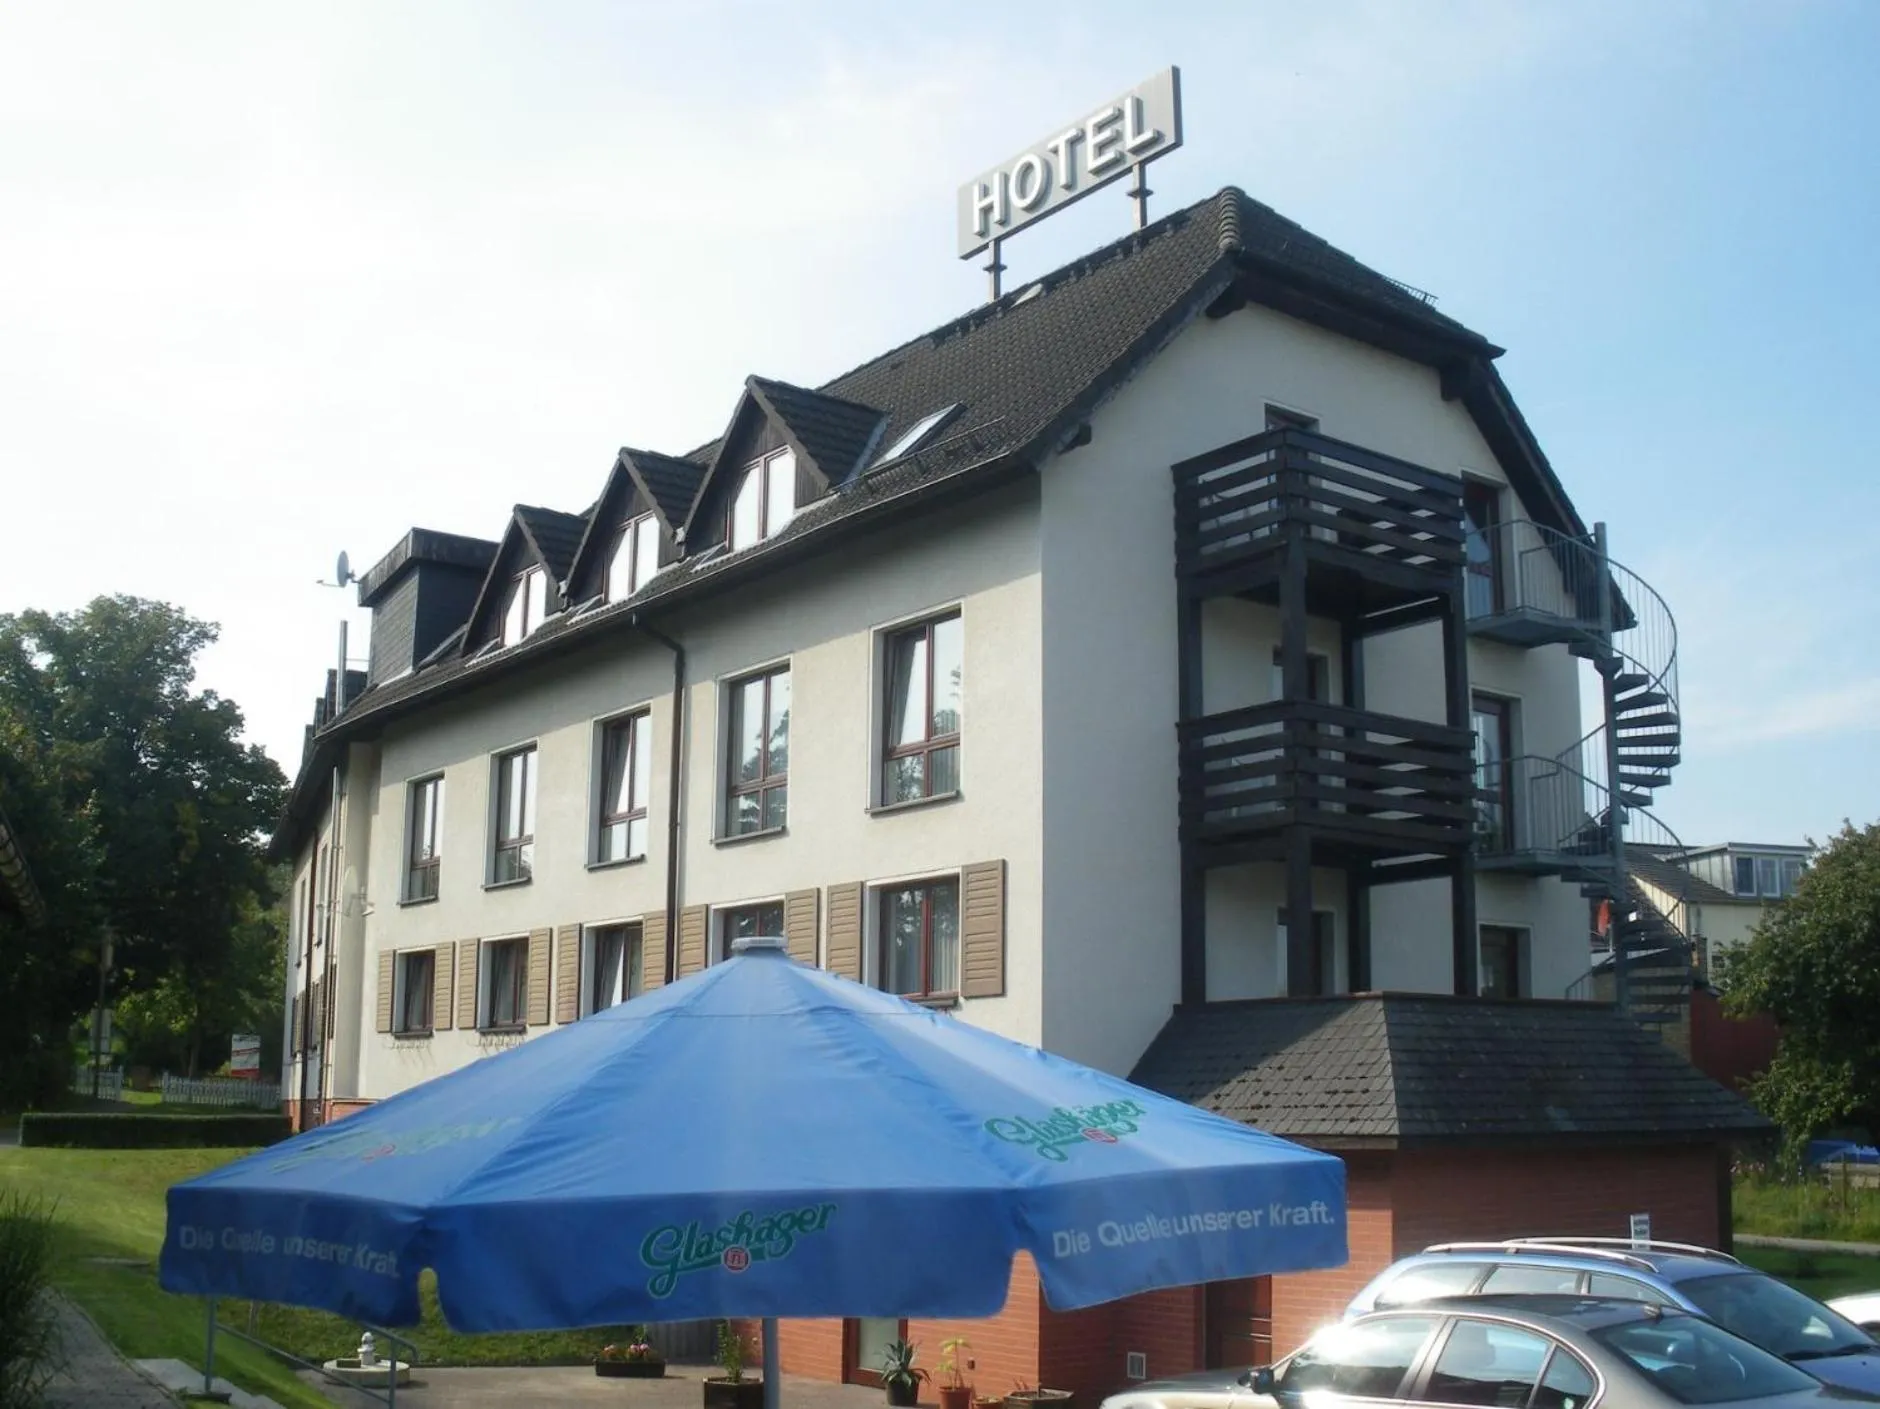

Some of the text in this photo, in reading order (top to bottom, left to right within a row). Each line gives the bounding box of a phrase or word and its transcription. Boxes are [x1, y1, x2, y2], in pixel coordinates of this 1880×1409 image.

[972, 95, 1164, 237] HOTEL
[1053, 1201, 1335, 1258] Die Quelle unserer Kraft.
